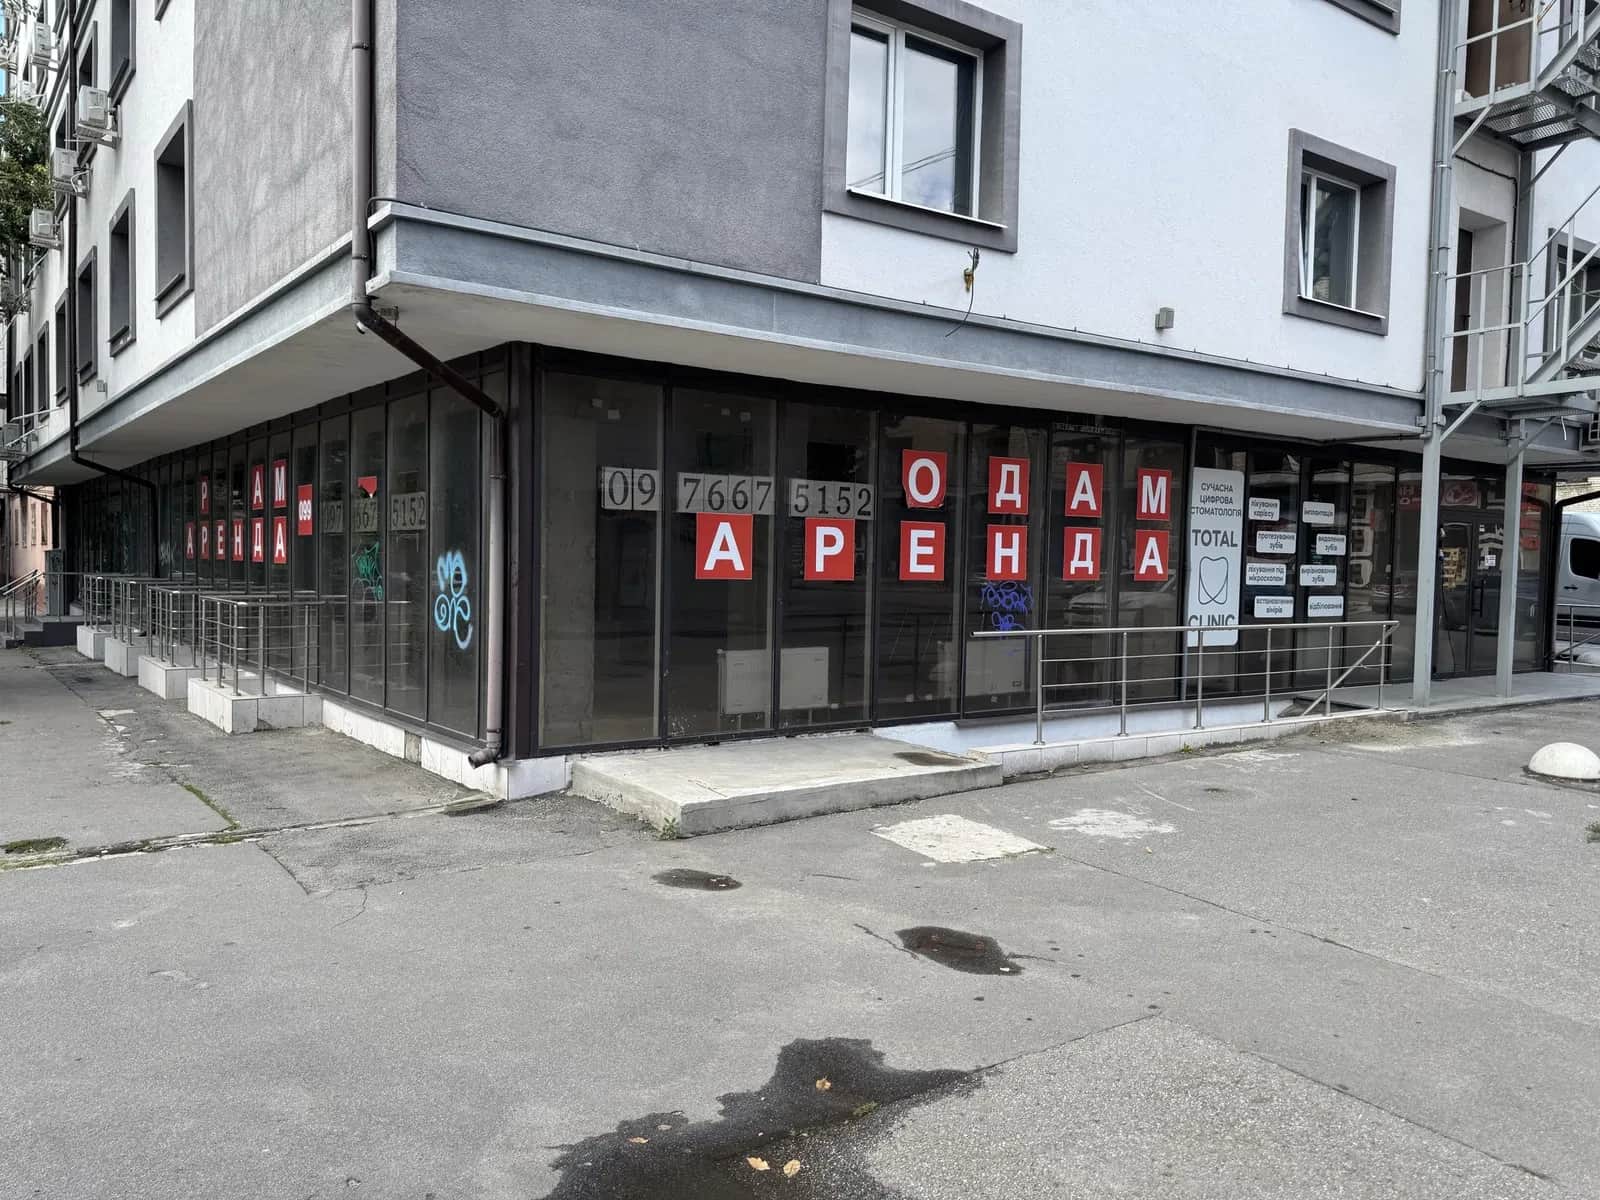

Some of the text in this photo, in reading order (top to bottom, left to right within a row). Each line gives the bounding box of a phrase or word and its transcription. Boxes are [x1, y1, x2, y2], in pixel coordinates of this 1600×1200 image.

[608, 470, 872, 516] 09 7667 5152
[908, 458, 1167, 514] ОДАМ
[1199, 495, 1234, 504] ЦИФРОВА
[1200, 482, 1234, 492] СУЧАСНА
[392, 495, 425, 528] 5152
[187, 522, 286, 558] АРЕНДА
[704, 521, 1164, 575] АРЕНДА
[1191, 529, 1238, 548] TOTAL
